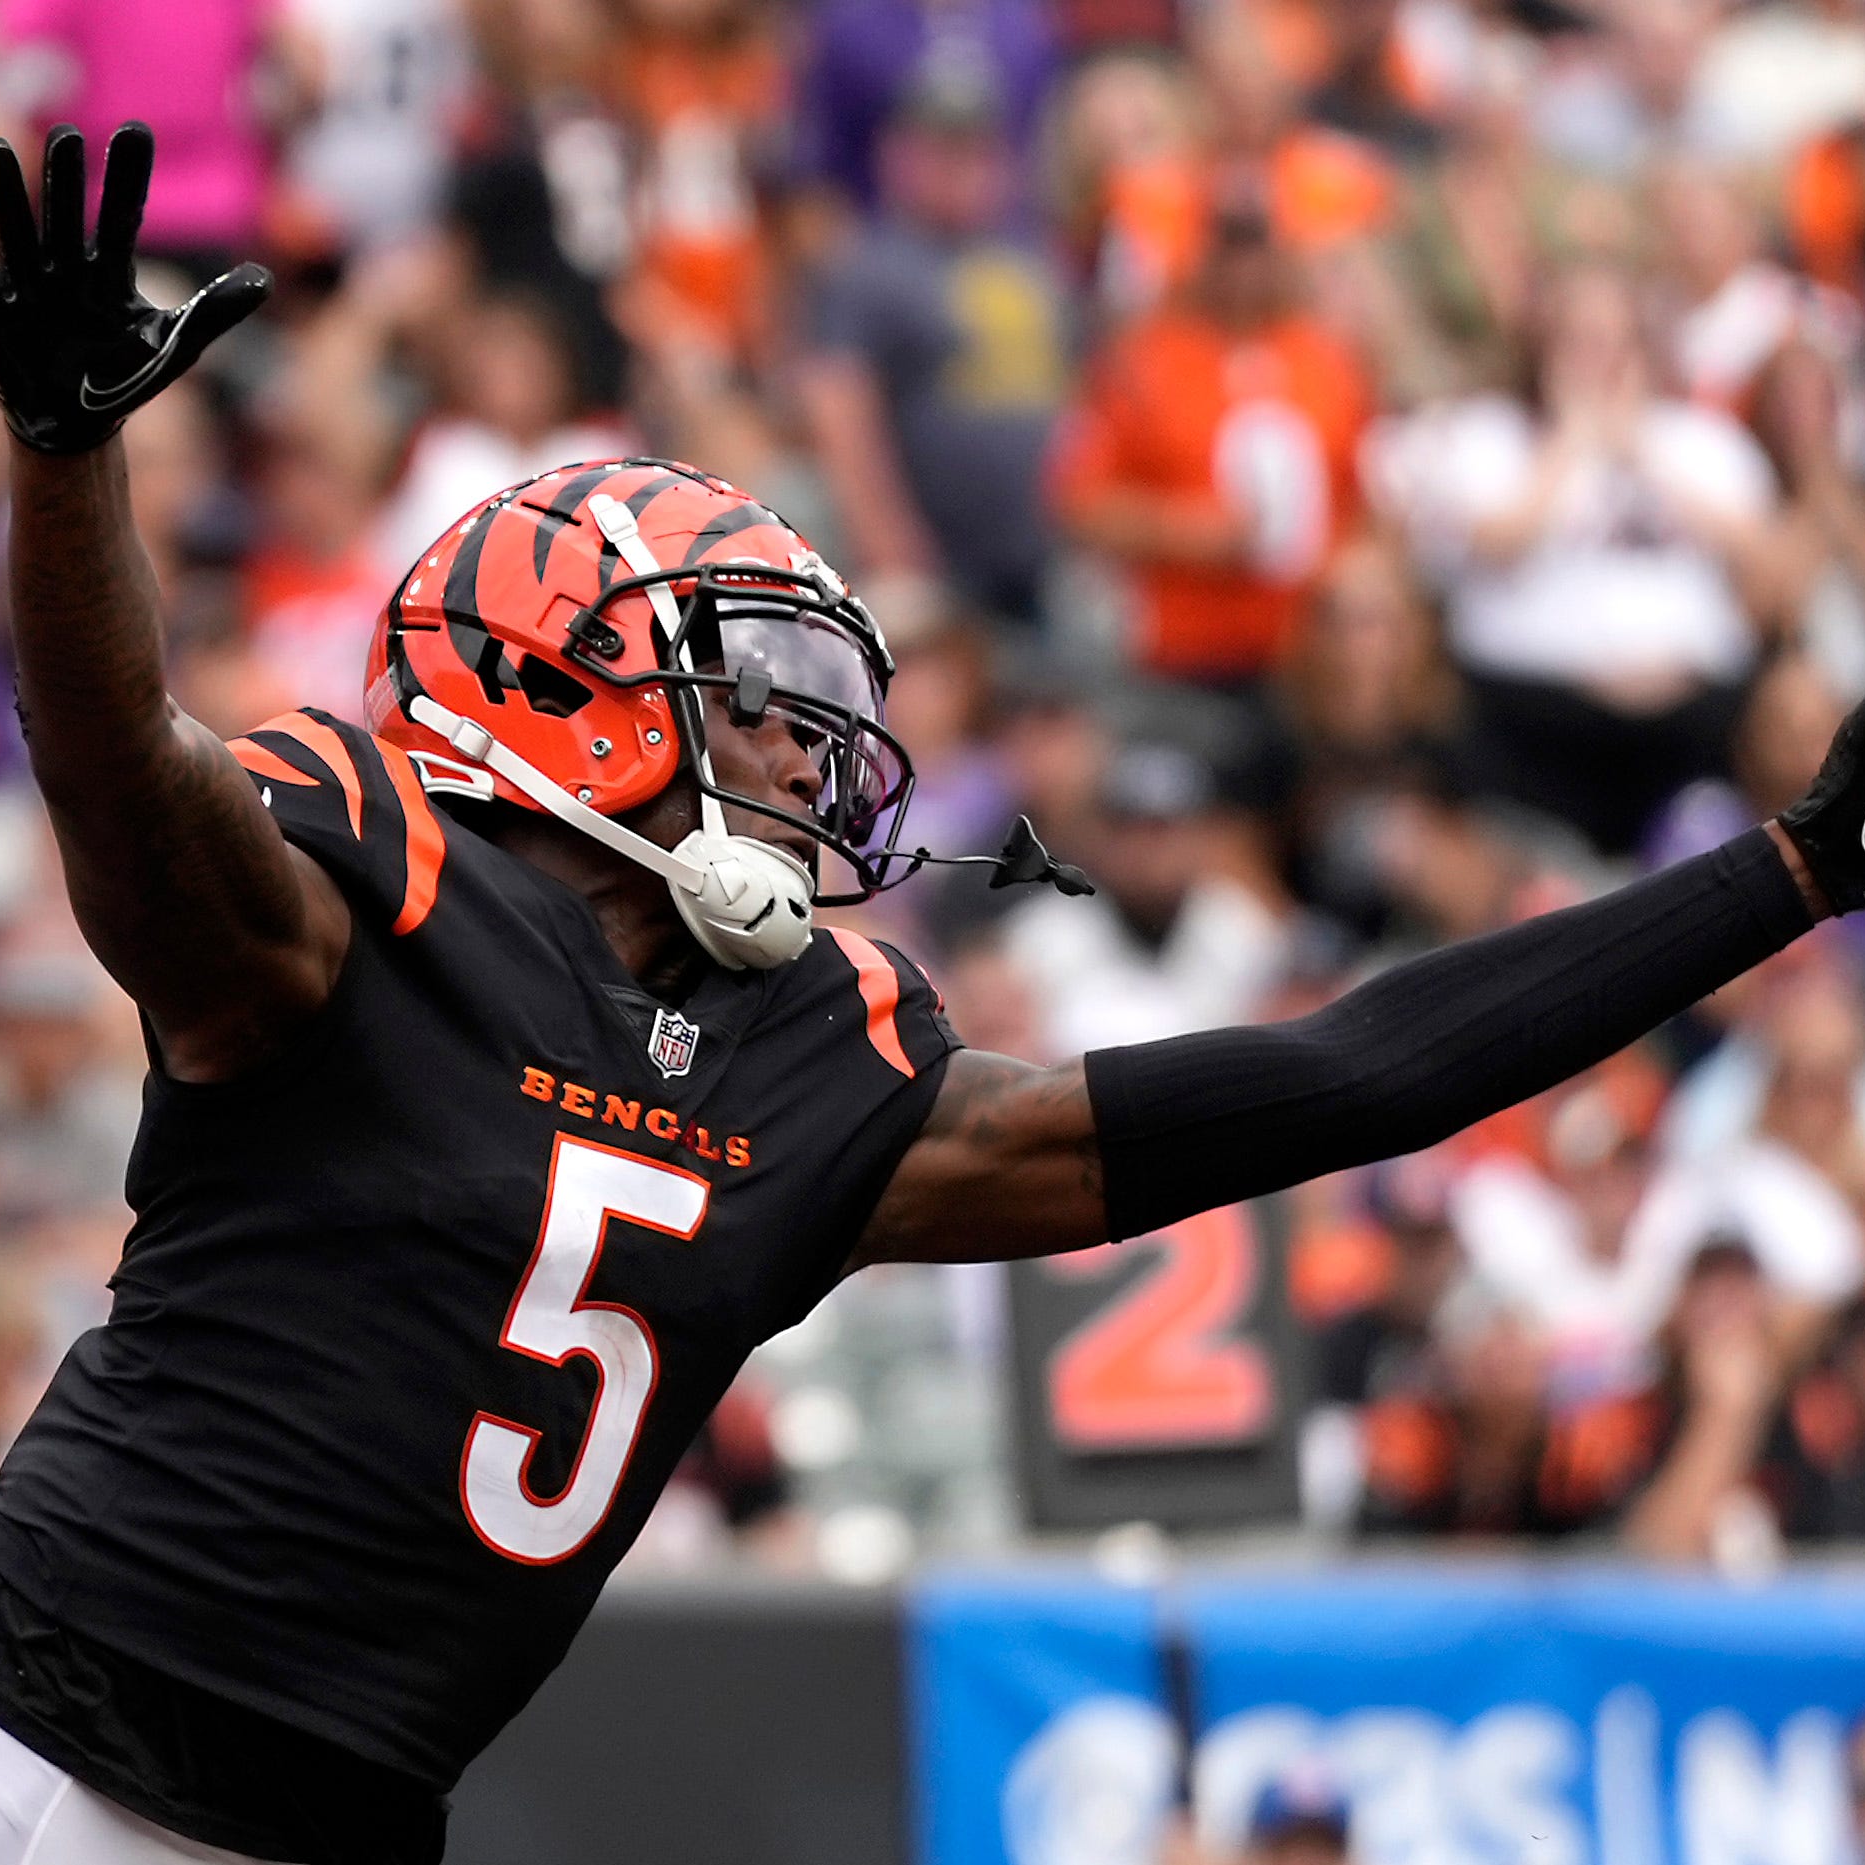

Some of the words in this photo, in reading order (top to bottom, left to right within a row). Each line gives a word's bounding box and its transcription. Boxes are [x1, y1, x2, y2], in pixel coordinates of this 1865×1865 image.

[520, 1065, 752, 1168] BENGALS
[459, 1130, 711, 1567] 5
[1041, 1203, 1275, 1448] 2
